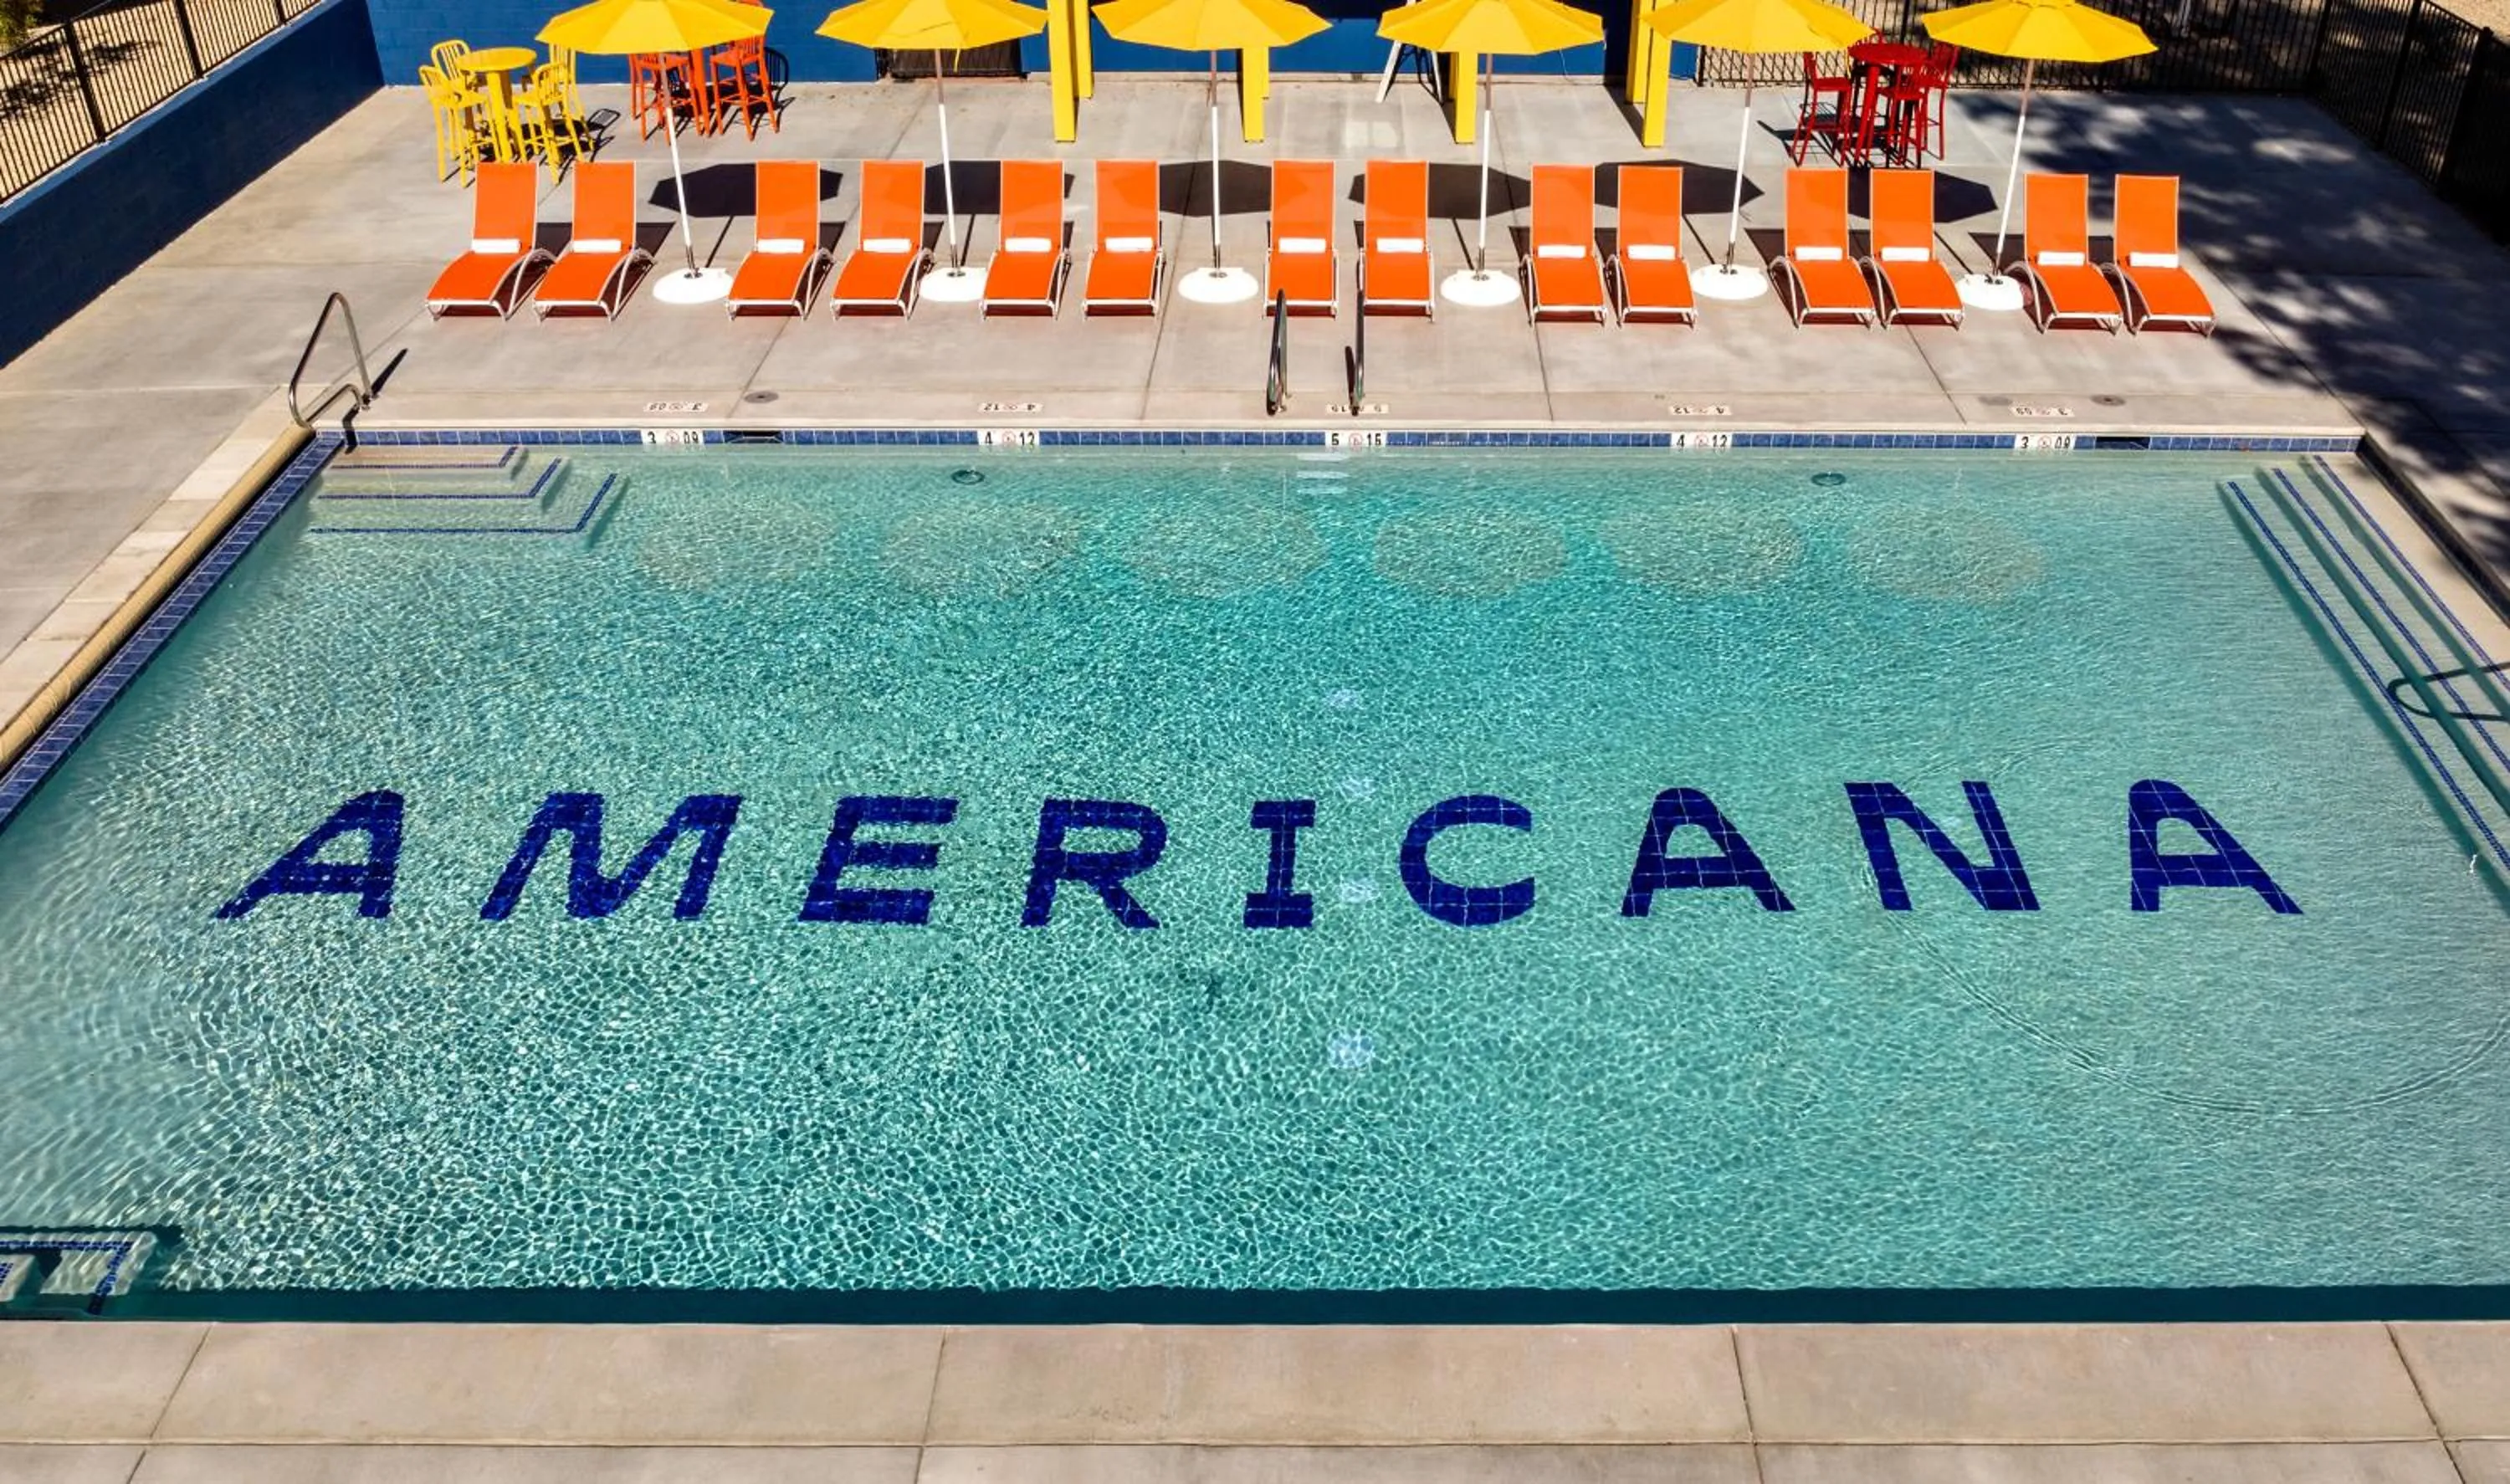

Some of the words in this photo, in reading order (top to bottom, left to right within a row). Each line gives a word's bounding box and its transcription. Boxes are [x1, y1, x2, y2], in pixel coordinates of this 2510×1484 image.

[647, 431, 657, 444] 3
[985, 431, 993, 445] 4
[1331, 432, 1340, 446] 5
[1367, 432, 1382, 446] 15
[1676, 434, 1686, 448] 4
[1712, 434, 1728, 448] 12
[2021, 436, 2030, 449] 3
[2054, 436, 2071, 449] 09
[217, 779, 2303, 929] AMERICANA
